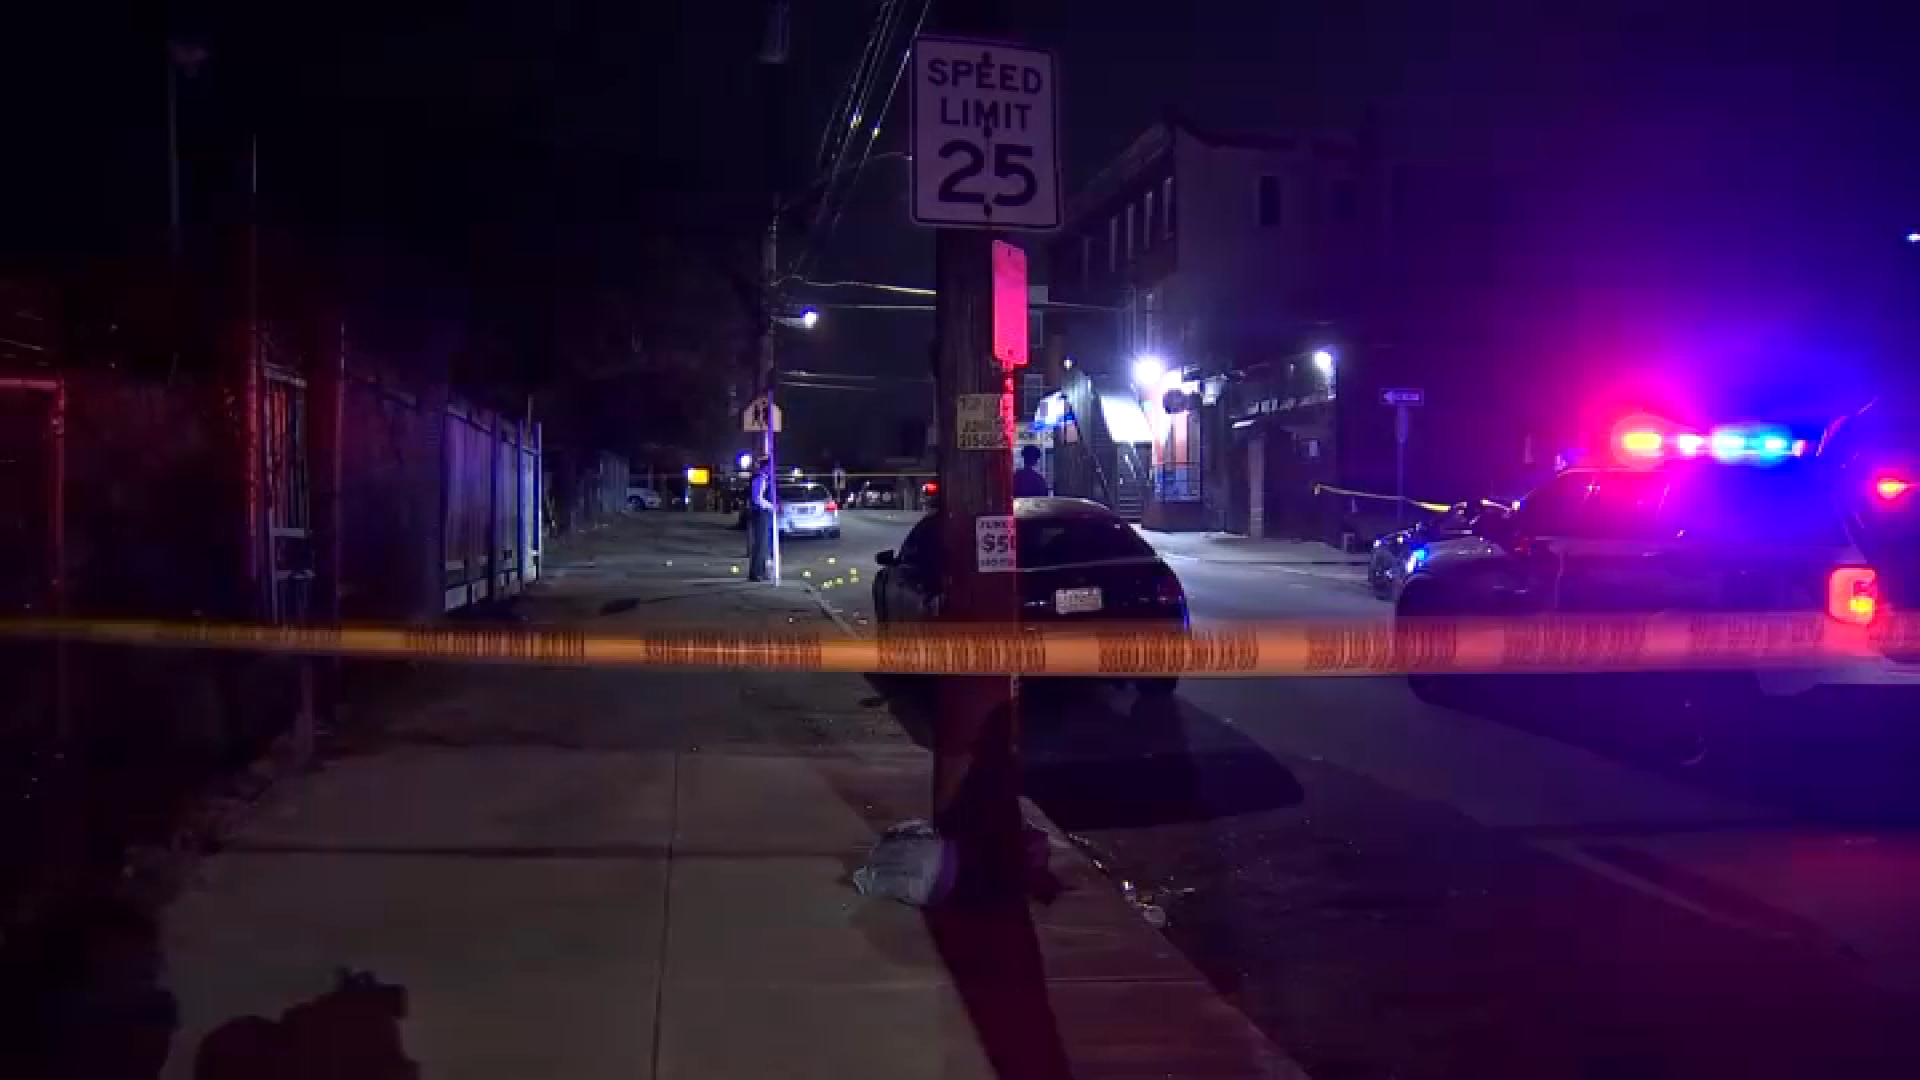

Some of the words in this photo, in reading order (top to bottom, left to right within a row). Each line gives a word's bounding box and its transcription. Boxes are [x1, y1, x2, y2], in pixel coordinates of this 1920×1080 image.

[928, 58, 1043, 94] SPEED
[941, 98, 1032, 132] LIMIT
[938, 139, 1038, 206] 25
